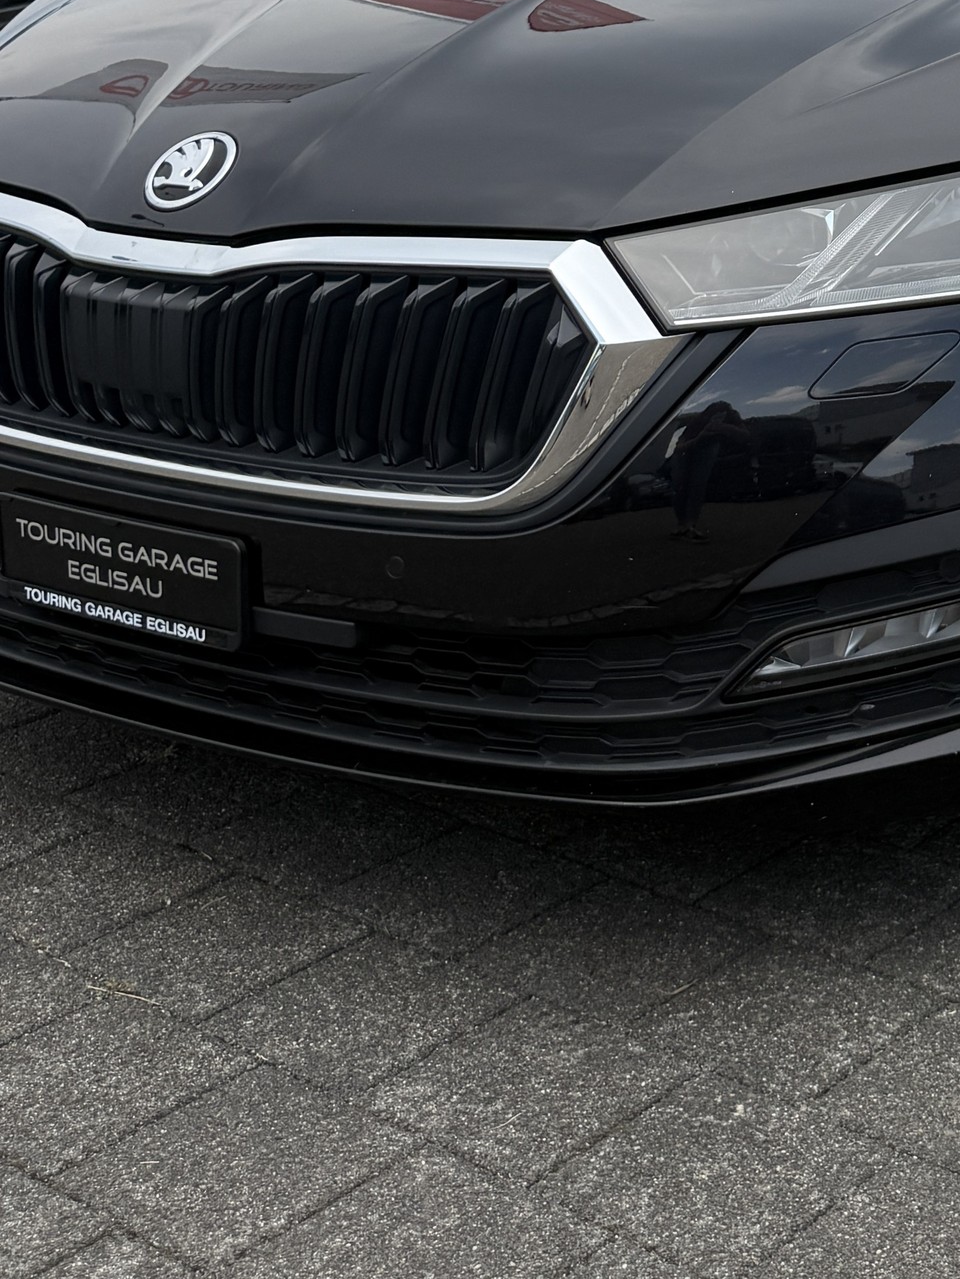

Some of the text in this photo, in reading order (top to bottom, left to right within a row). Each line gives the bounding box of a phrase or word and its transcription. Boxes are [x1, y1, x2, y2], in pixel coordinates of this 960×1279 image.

[16, 517, 219, 581] TOURING GARAGE
[67, 559, 163, 599] EGLISAU
[24, 586, 206, 643] TOURING GARAGE EGLISAU
